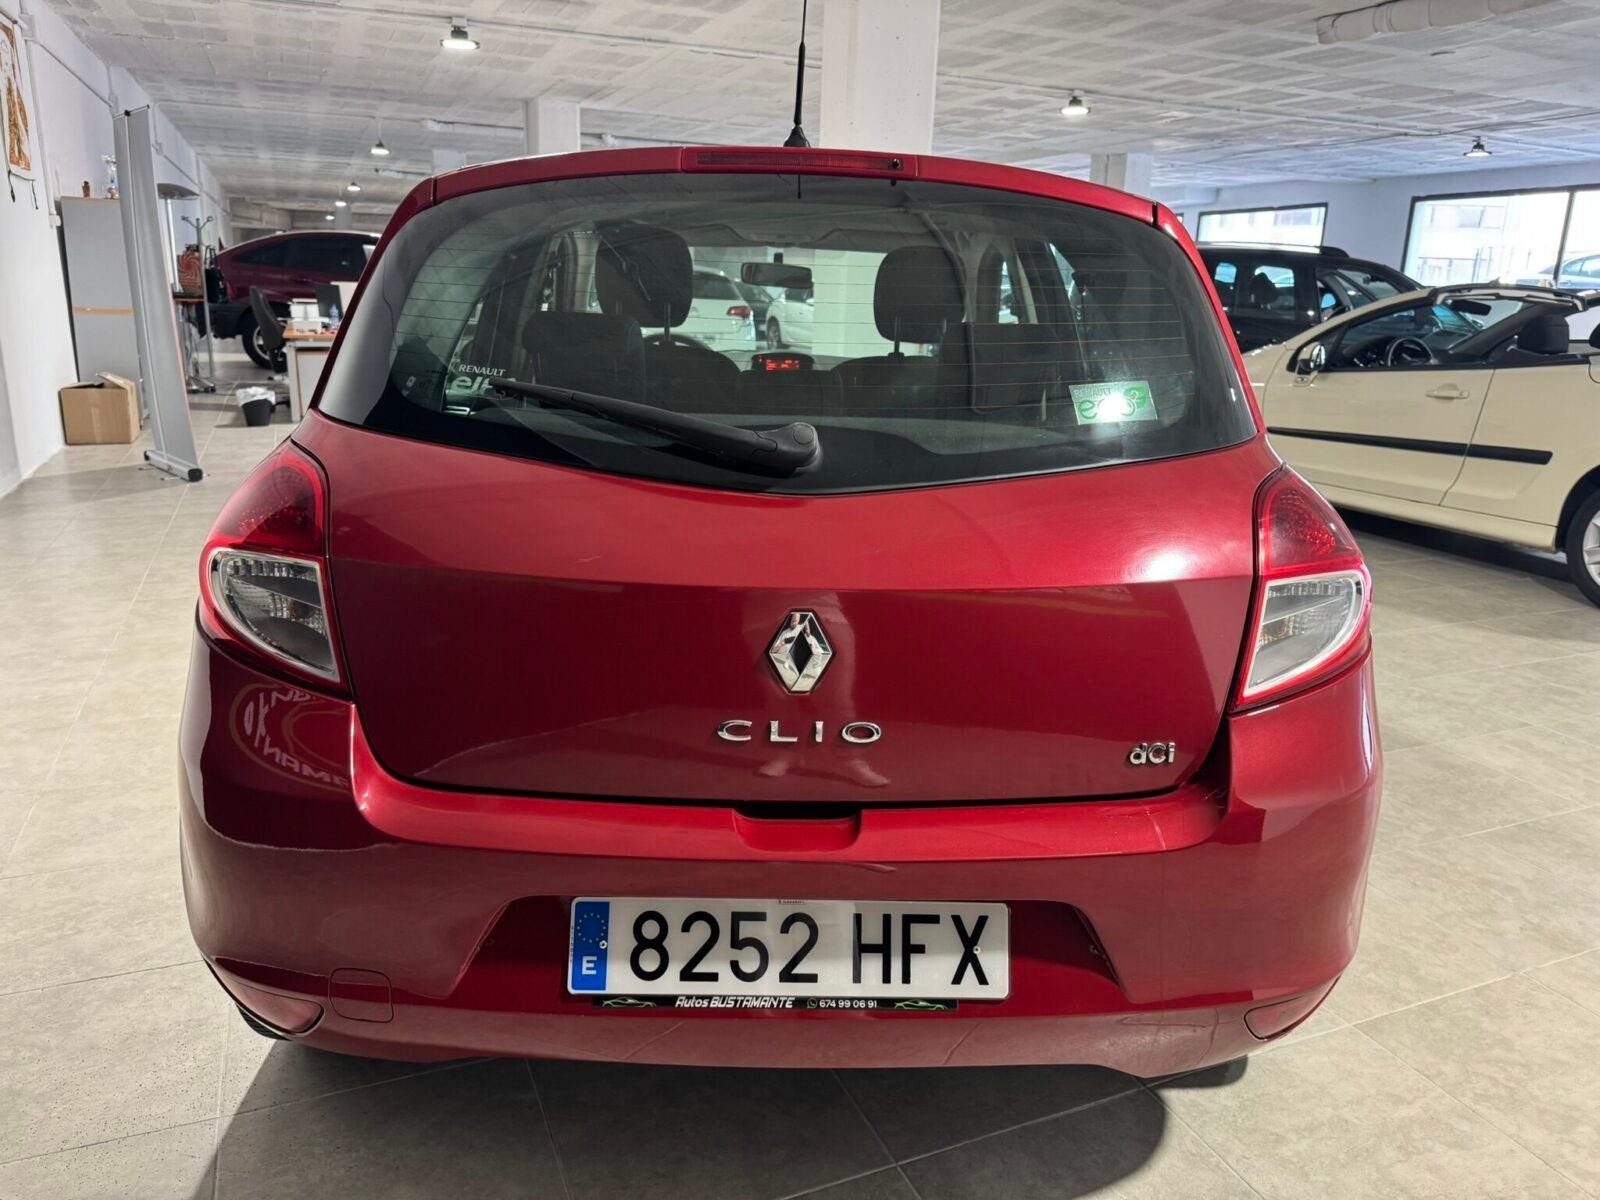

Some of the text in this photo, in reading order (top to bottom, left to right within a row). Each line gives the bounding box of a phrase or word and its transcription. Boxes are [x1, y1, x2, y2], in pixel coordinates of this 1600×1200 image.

[458, 364, 506, 376] RENAULT
[717, 719, 882, 743] CLIO
[1129, 742, 1176, 764] dCi
[581, 955, 597, 975] E
[630, 910, 819, 983] 8252
[852, 913, 990, 985] HFX
[675, 996, 878, 1009] Autos BUSTAMANTE 674 99 06 91
